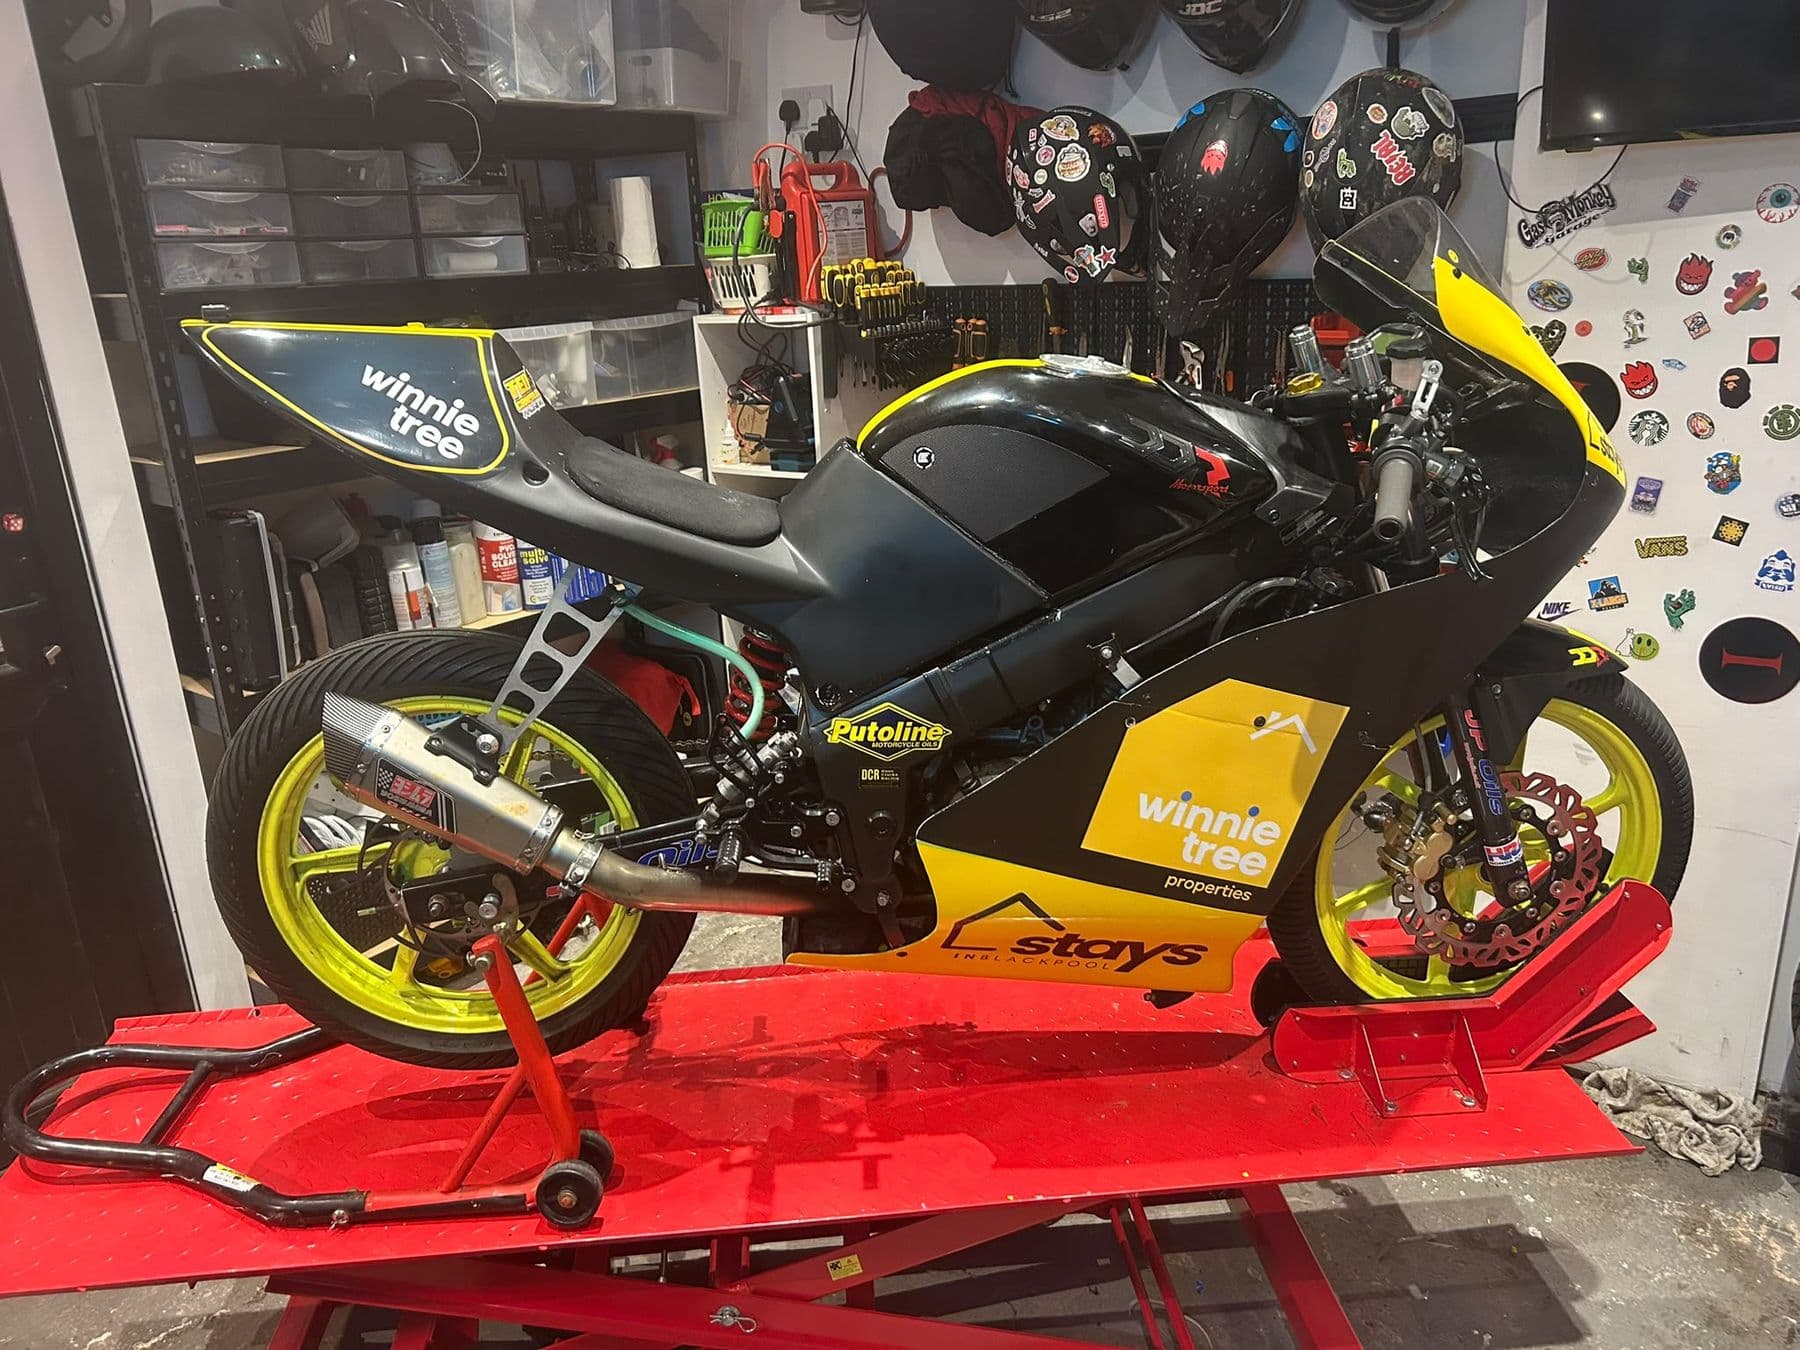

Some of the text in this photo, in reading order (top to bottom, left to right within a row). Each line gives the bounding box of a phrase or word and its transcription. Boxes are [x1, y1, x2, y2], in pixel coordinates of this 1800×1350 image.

[1517, 183, 1617, 248] Gas Monkey
[361, 364, 480, 437] winnie
[389, 404, 465, 460] tree
[520, 548, 545, 559] multi
[1634, 536, 1689, 558] VANS
[1542, 602, 1572, 615] NIKE
[830, 719, 945, 744] Putoline
[921, 740, 938, 748] OILS
[1463, 709, 1488, 752] JP
[861, 768, 880, 781] DCR
[1138, 790, 1281, 846] winnie
[1181, 831, 1268, 876] tree
[1164, 875, 1253, 902] properties
[1010, 933, 1209, 973] stays
